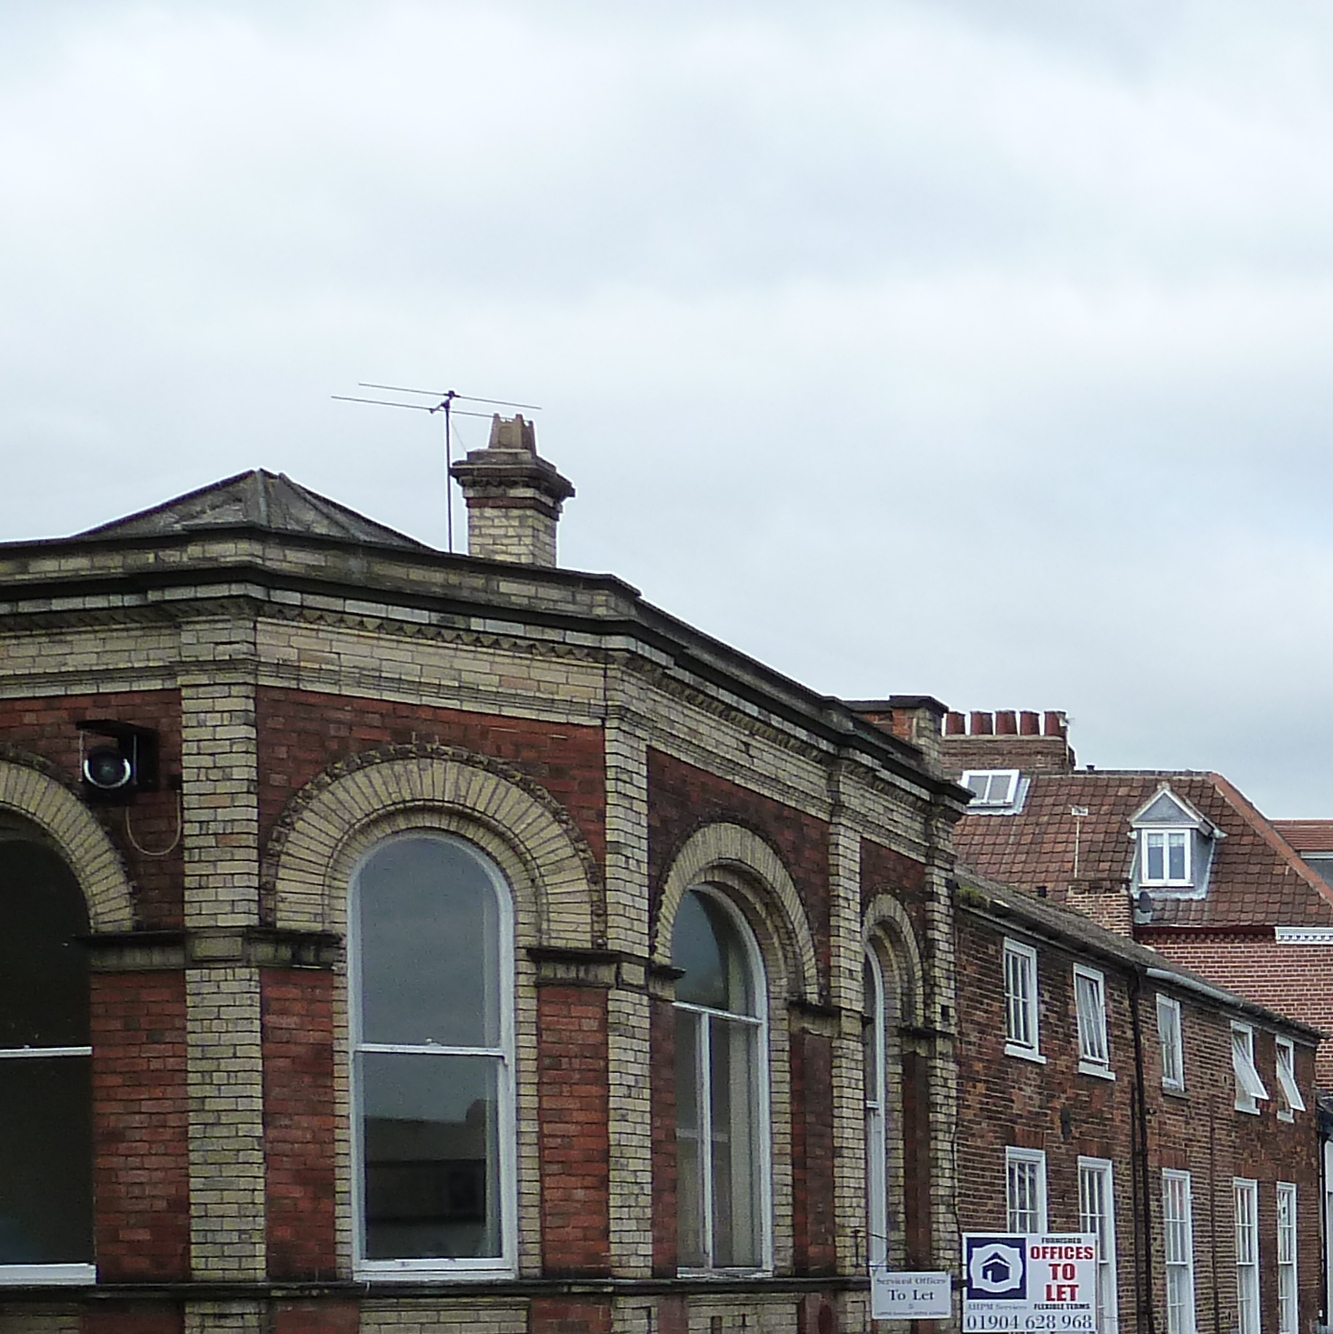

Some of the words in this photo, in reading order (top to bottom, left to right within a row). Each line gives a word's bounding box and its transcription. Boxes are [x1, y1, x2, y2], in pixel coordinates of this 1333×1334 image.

[1030, 1246, 1094, 1260] OFFICES
[1048, 1263, 1076, 1281] TO
[887, 1288, 907, 1301] To
[912, 1288, 934, 1301] Let
[1045, 1284, 1080, 1302] LET
[967, 1314, 1018, 1330] 01904
[1025, 1314, 1056, 1330] 628
[1061, 1314, 1092, 1330] 968
